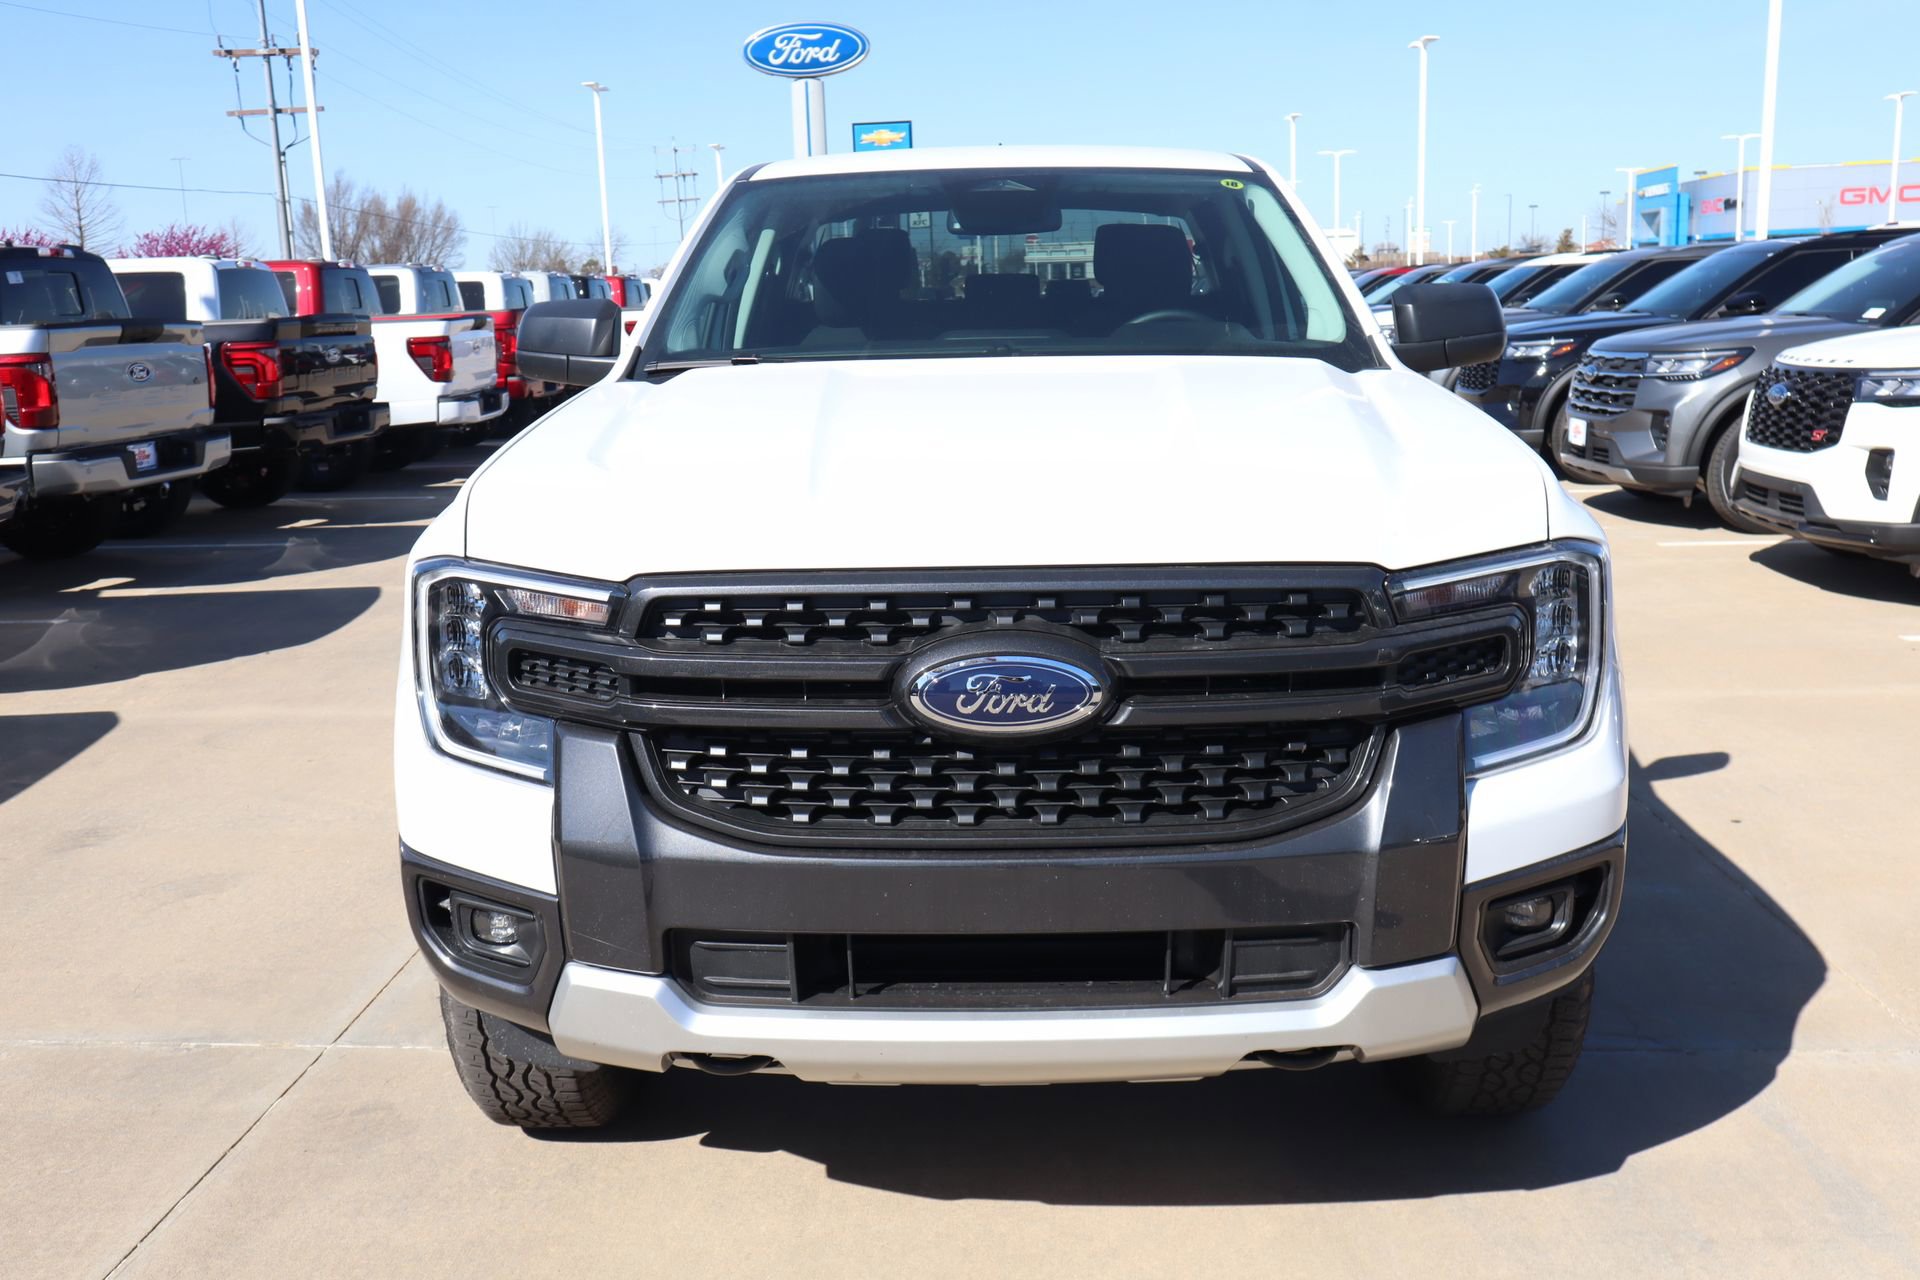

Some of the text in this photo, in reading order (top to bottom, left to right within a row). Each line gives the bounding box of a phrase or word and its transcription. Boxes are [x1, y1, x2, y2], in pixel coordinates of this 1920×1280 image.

[768, 32, 841, 65] Ford
[1840, 184, 1920, 205] GMC
[955, 674, 1057, 714] Ford
